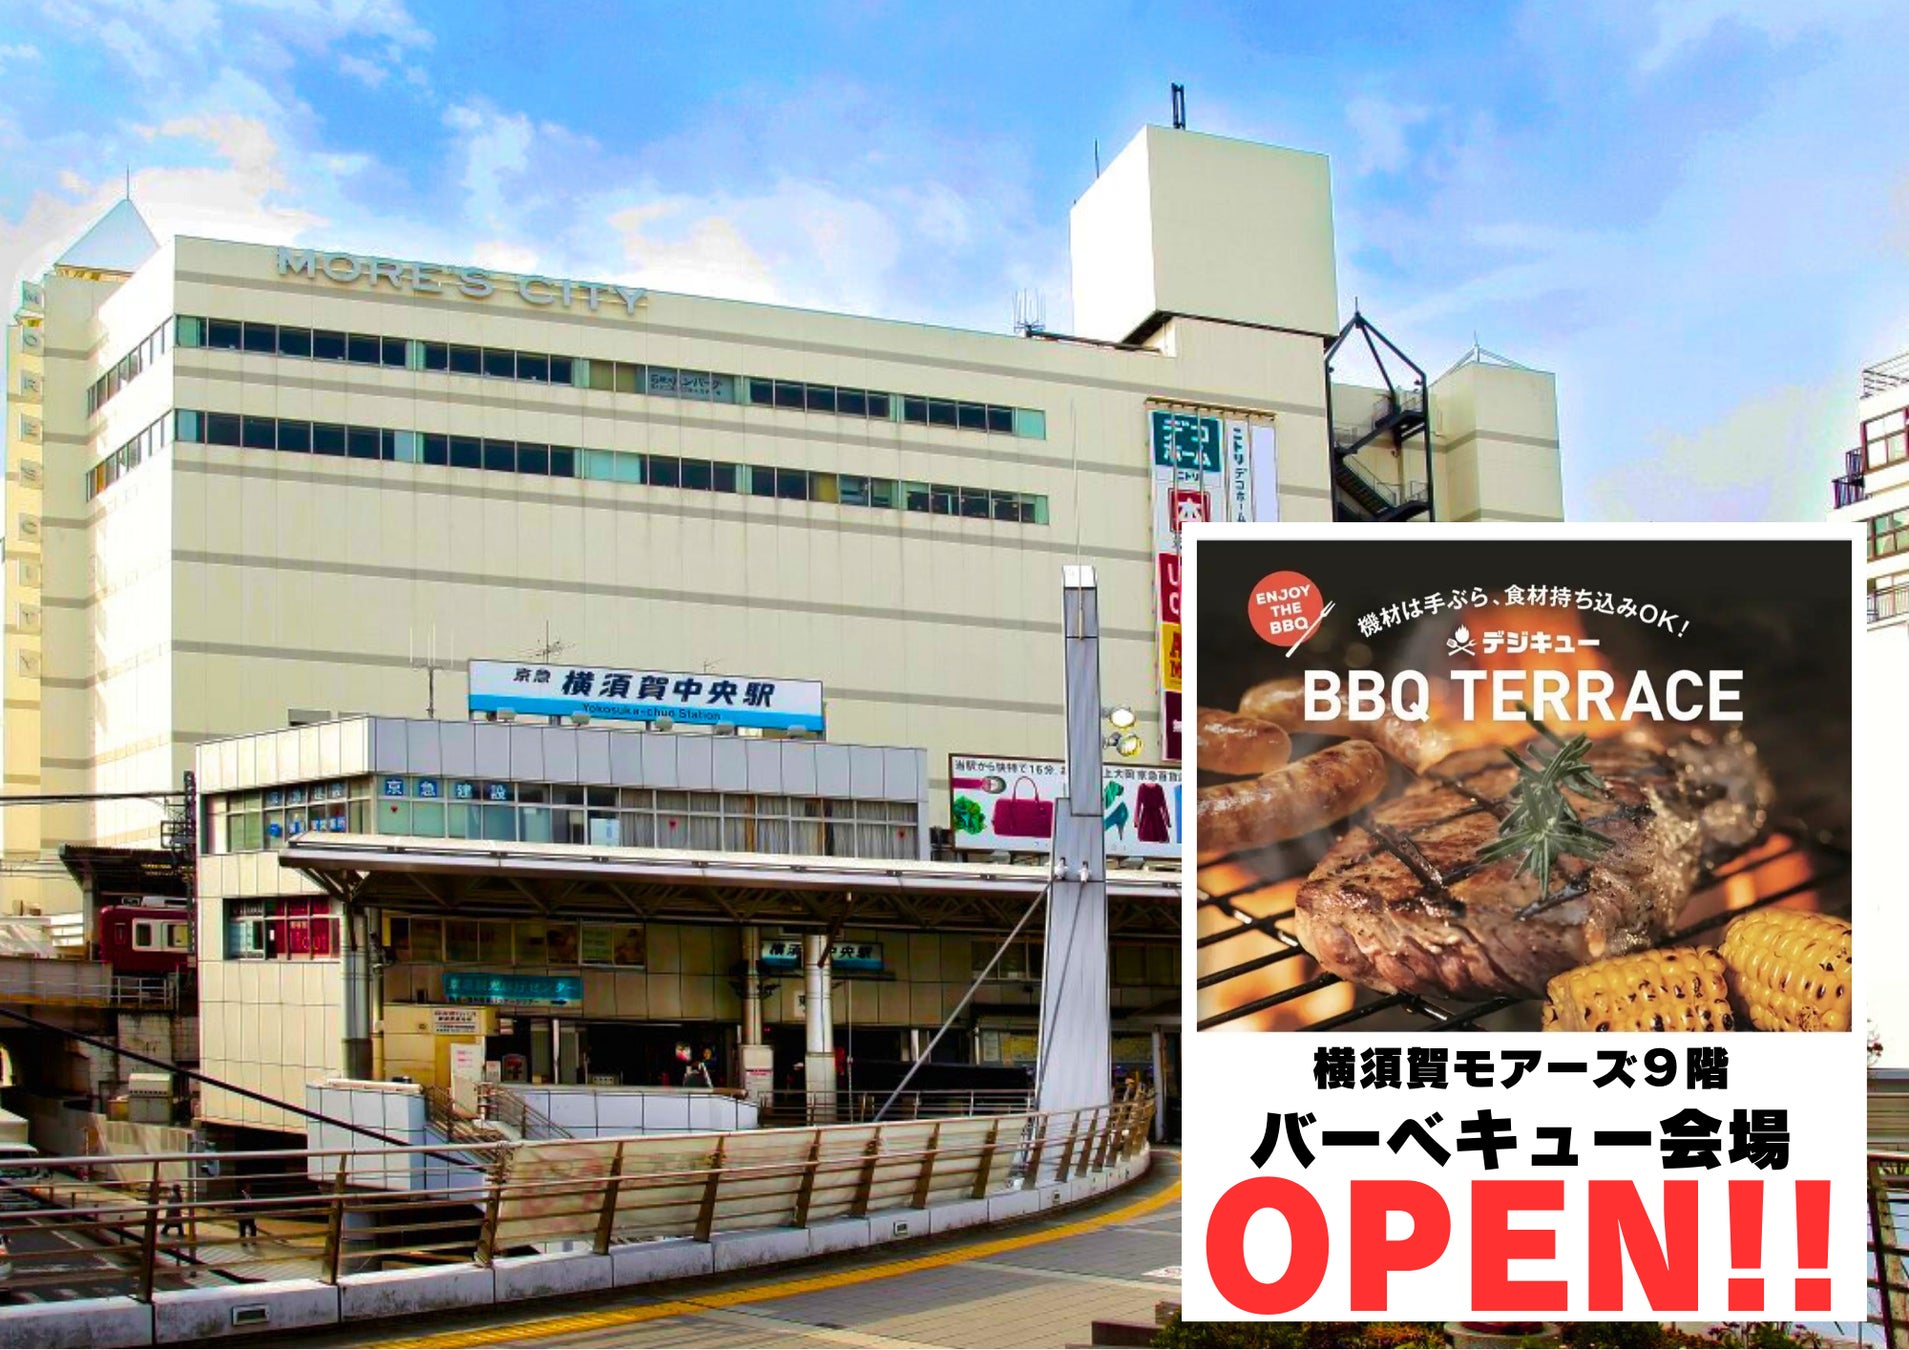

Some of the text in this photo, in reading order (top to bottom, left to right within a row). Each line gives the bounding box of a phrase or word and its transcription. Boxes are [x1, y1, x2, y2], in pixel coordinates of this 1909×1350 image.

[277, 246, 648, 315] MORE'S CITY
[511, 666, 777, 708] 京急 横須賀中央駅
[677, 709, 722, 722] Station
